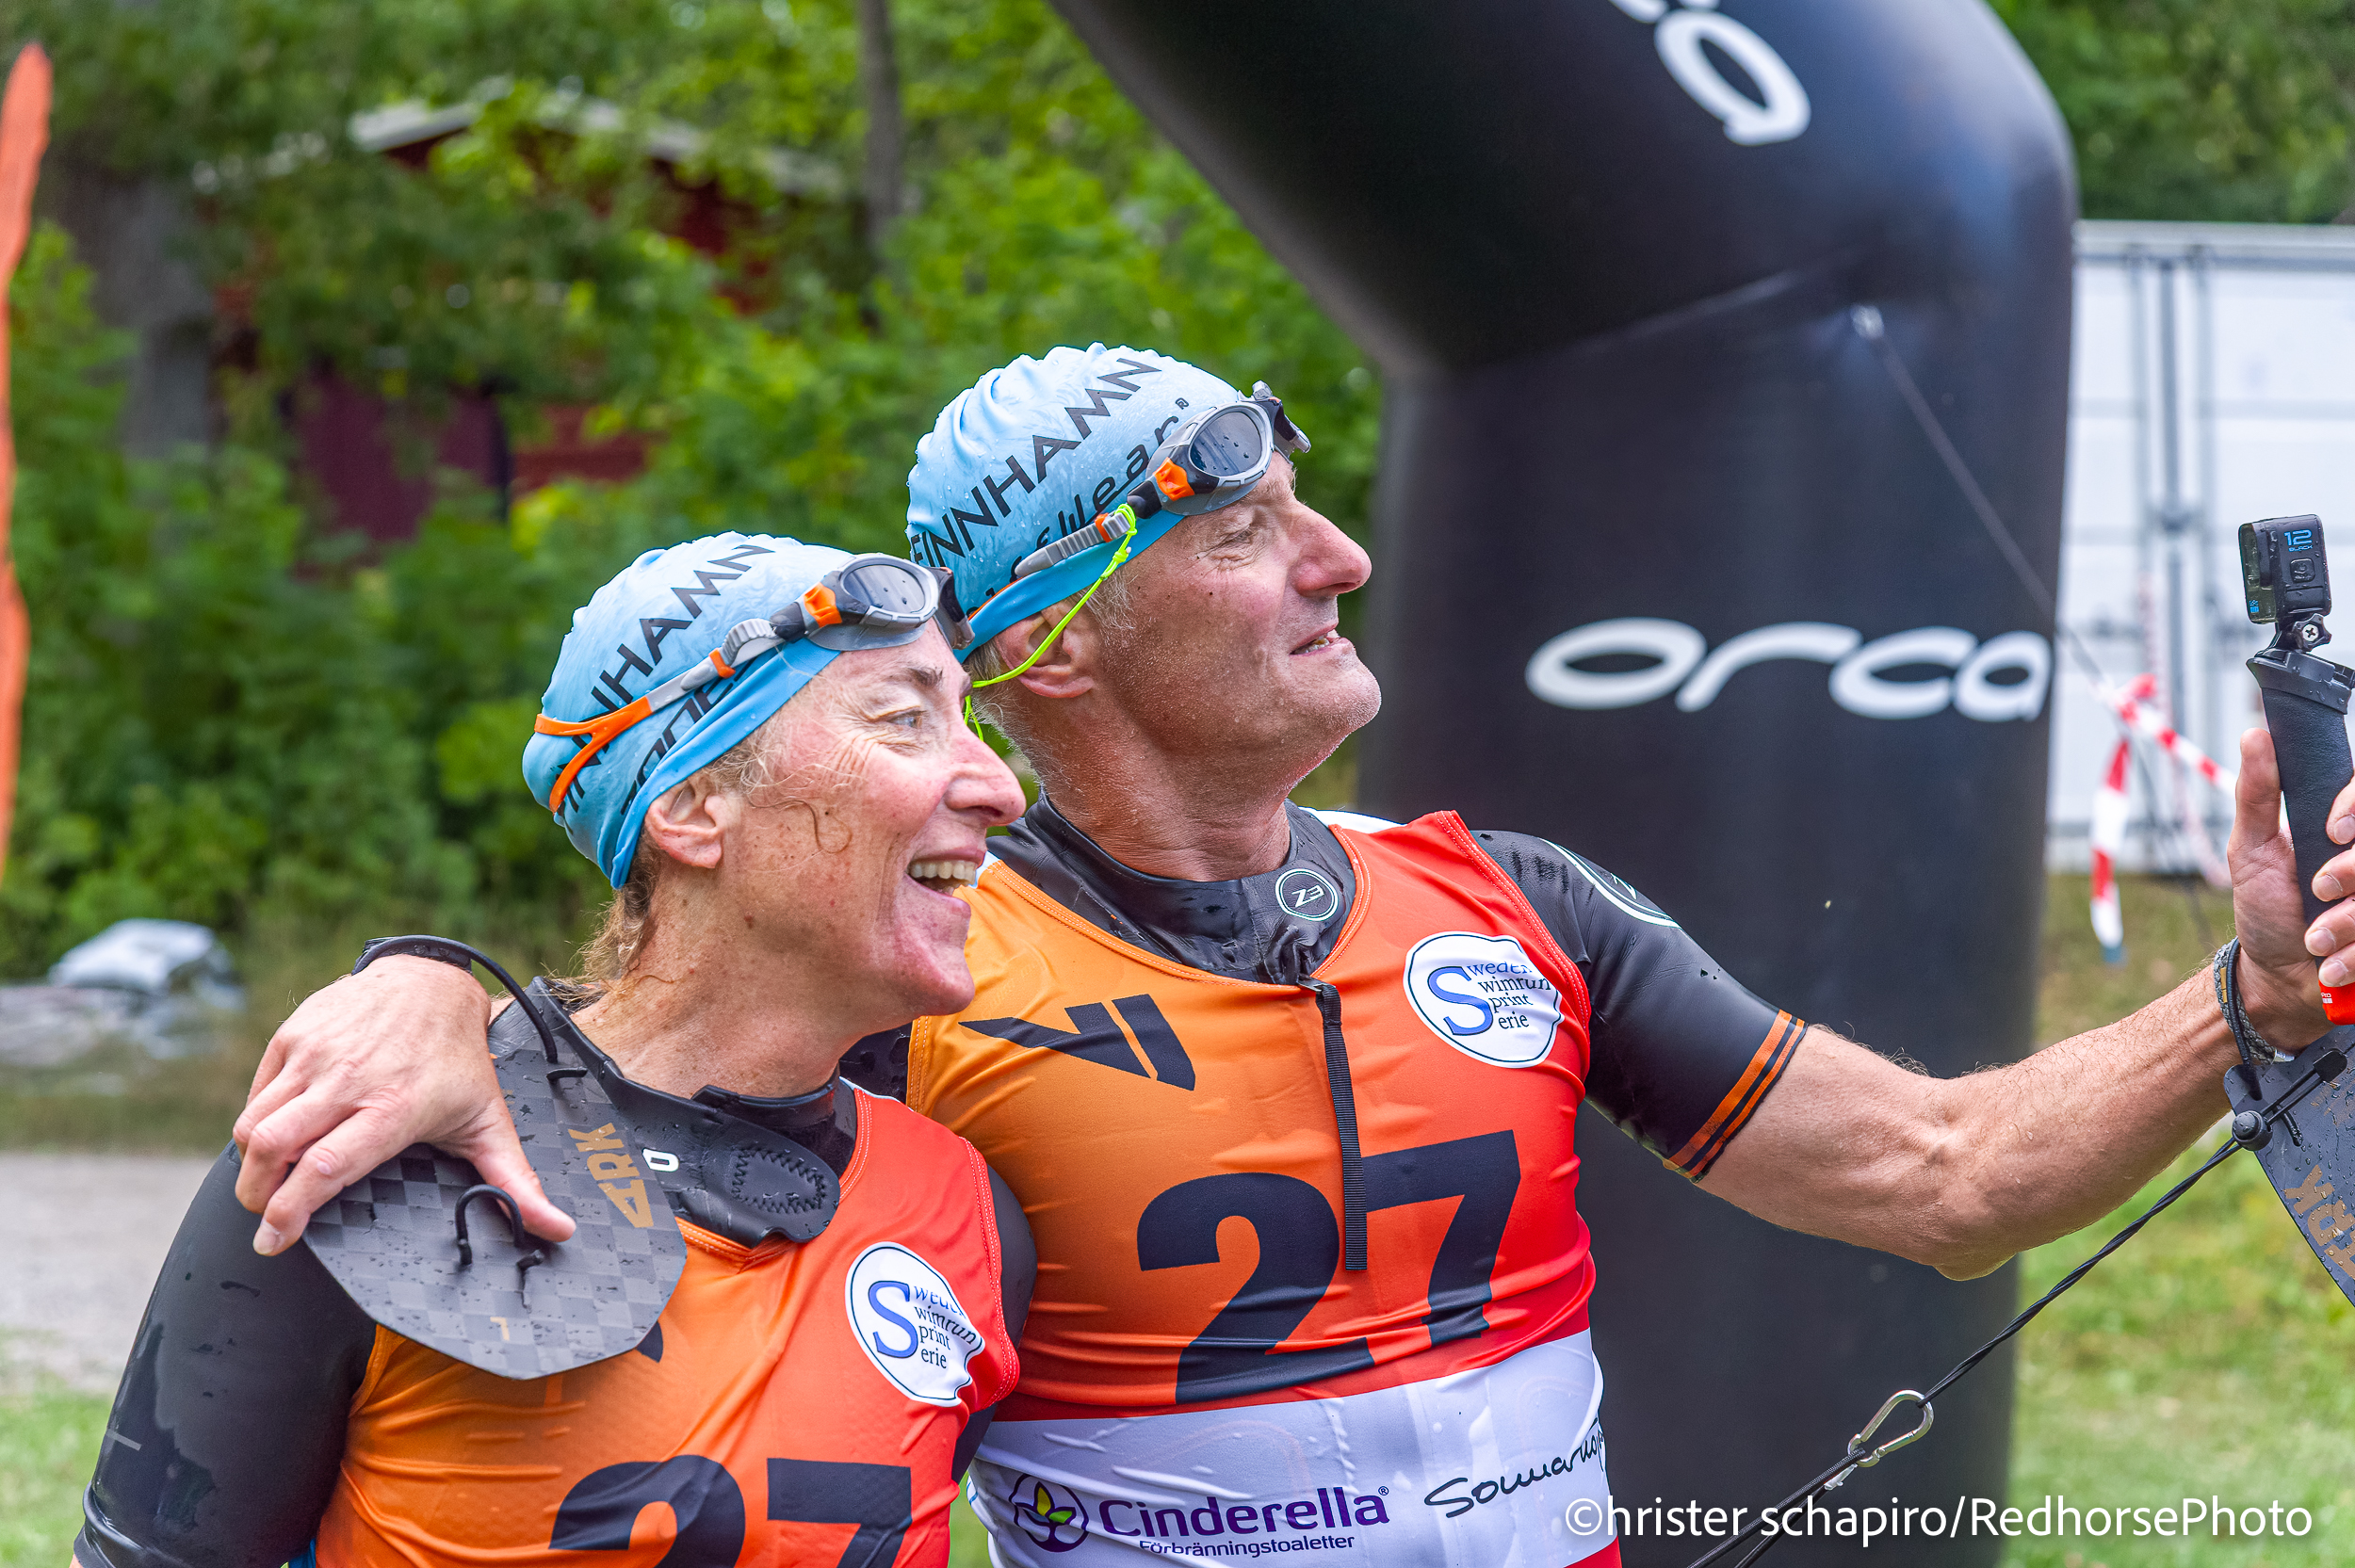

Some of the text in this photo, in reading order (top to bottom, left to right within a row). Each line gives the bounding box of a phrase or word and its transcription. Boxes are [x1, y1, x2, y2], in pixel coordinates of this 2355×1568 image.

[2283, 529, 2313, 546] 12
[1525, 616, 2052, 722] orca
[568, 1123, 654, 1228] ARK
[1136, 1129, 1521, 1405] 27
[1139, 1535, 1356, 1558] Förbränningstoaletter
